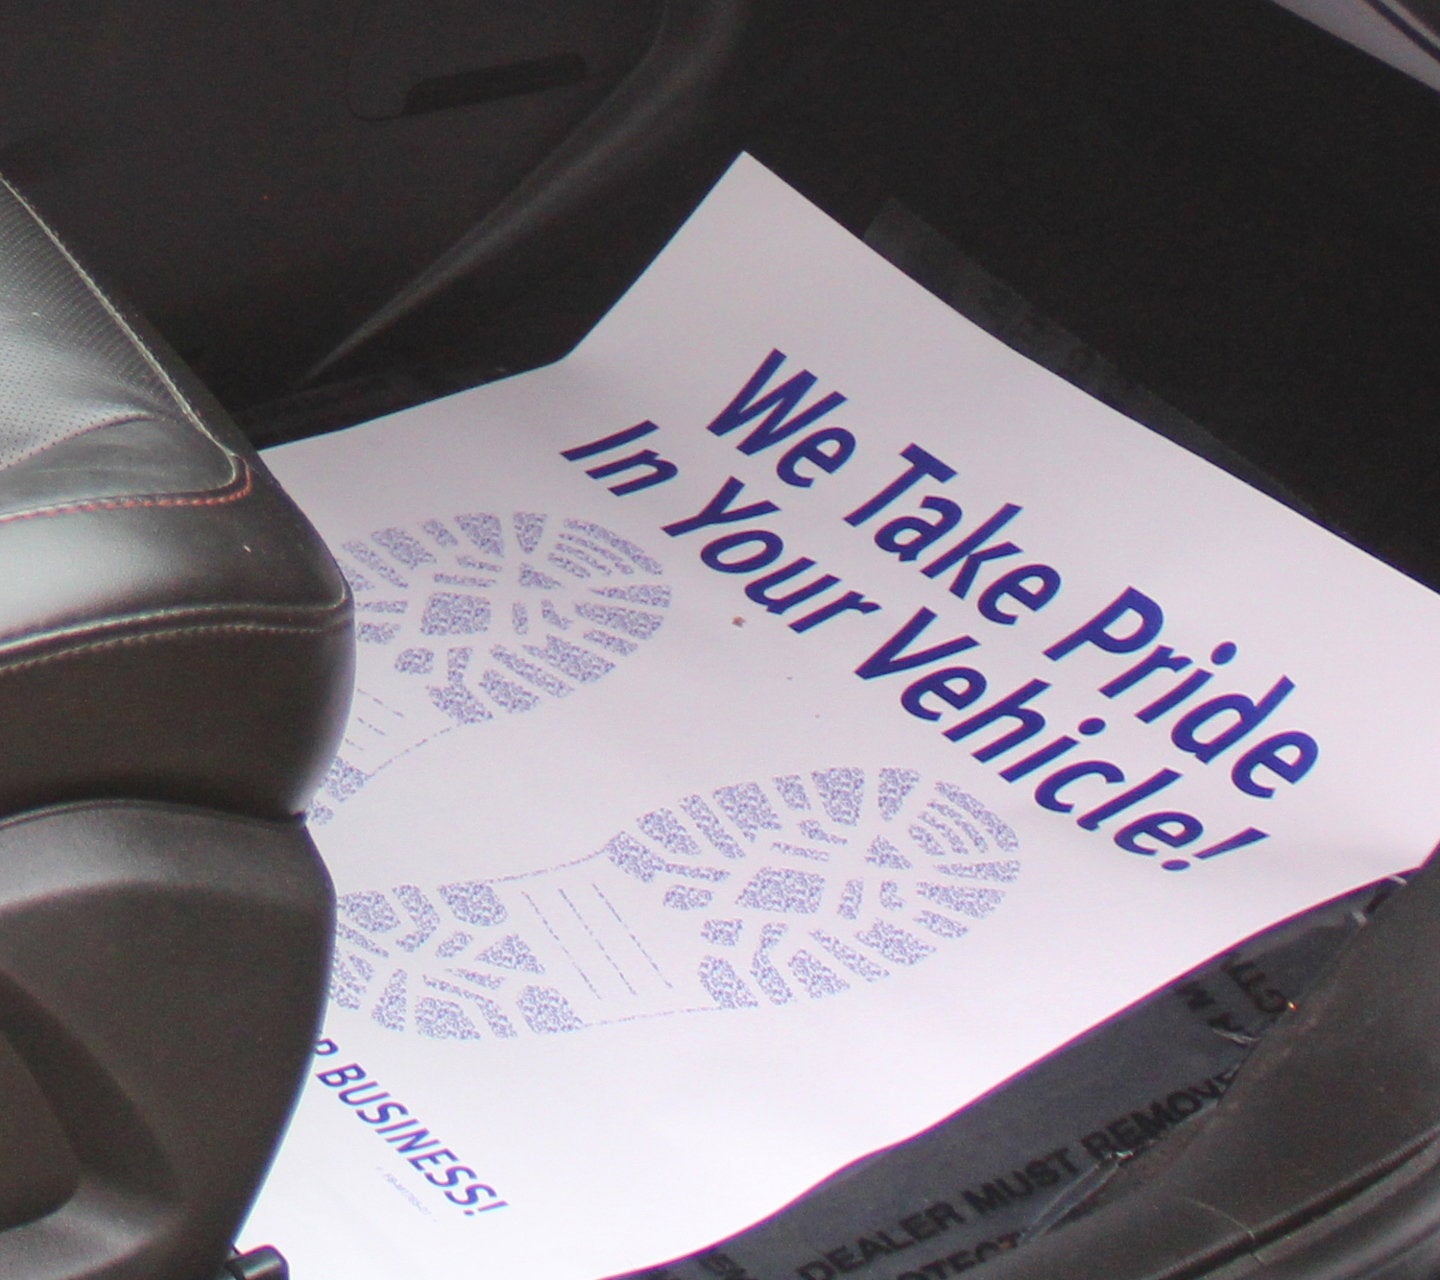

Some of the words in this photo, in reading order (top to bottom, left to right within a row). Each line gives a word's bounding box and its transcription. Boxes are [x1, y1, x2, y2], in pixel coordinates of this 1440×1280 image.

[560, 420, 678, 497] In
[661, 476, 881, 634] Your
[855, 606, 1269, 872] Vehicle!
[706, 348, 856, 488] We
[843, 443, 1062, 626] Take
[1042, 586, 1319, 799] Pride
[315, 1062, 509, 1216] BUSINESS!
[797, 1203, 966, 1280] DEALER
[963, 1147, 1081, 1215] MUST
